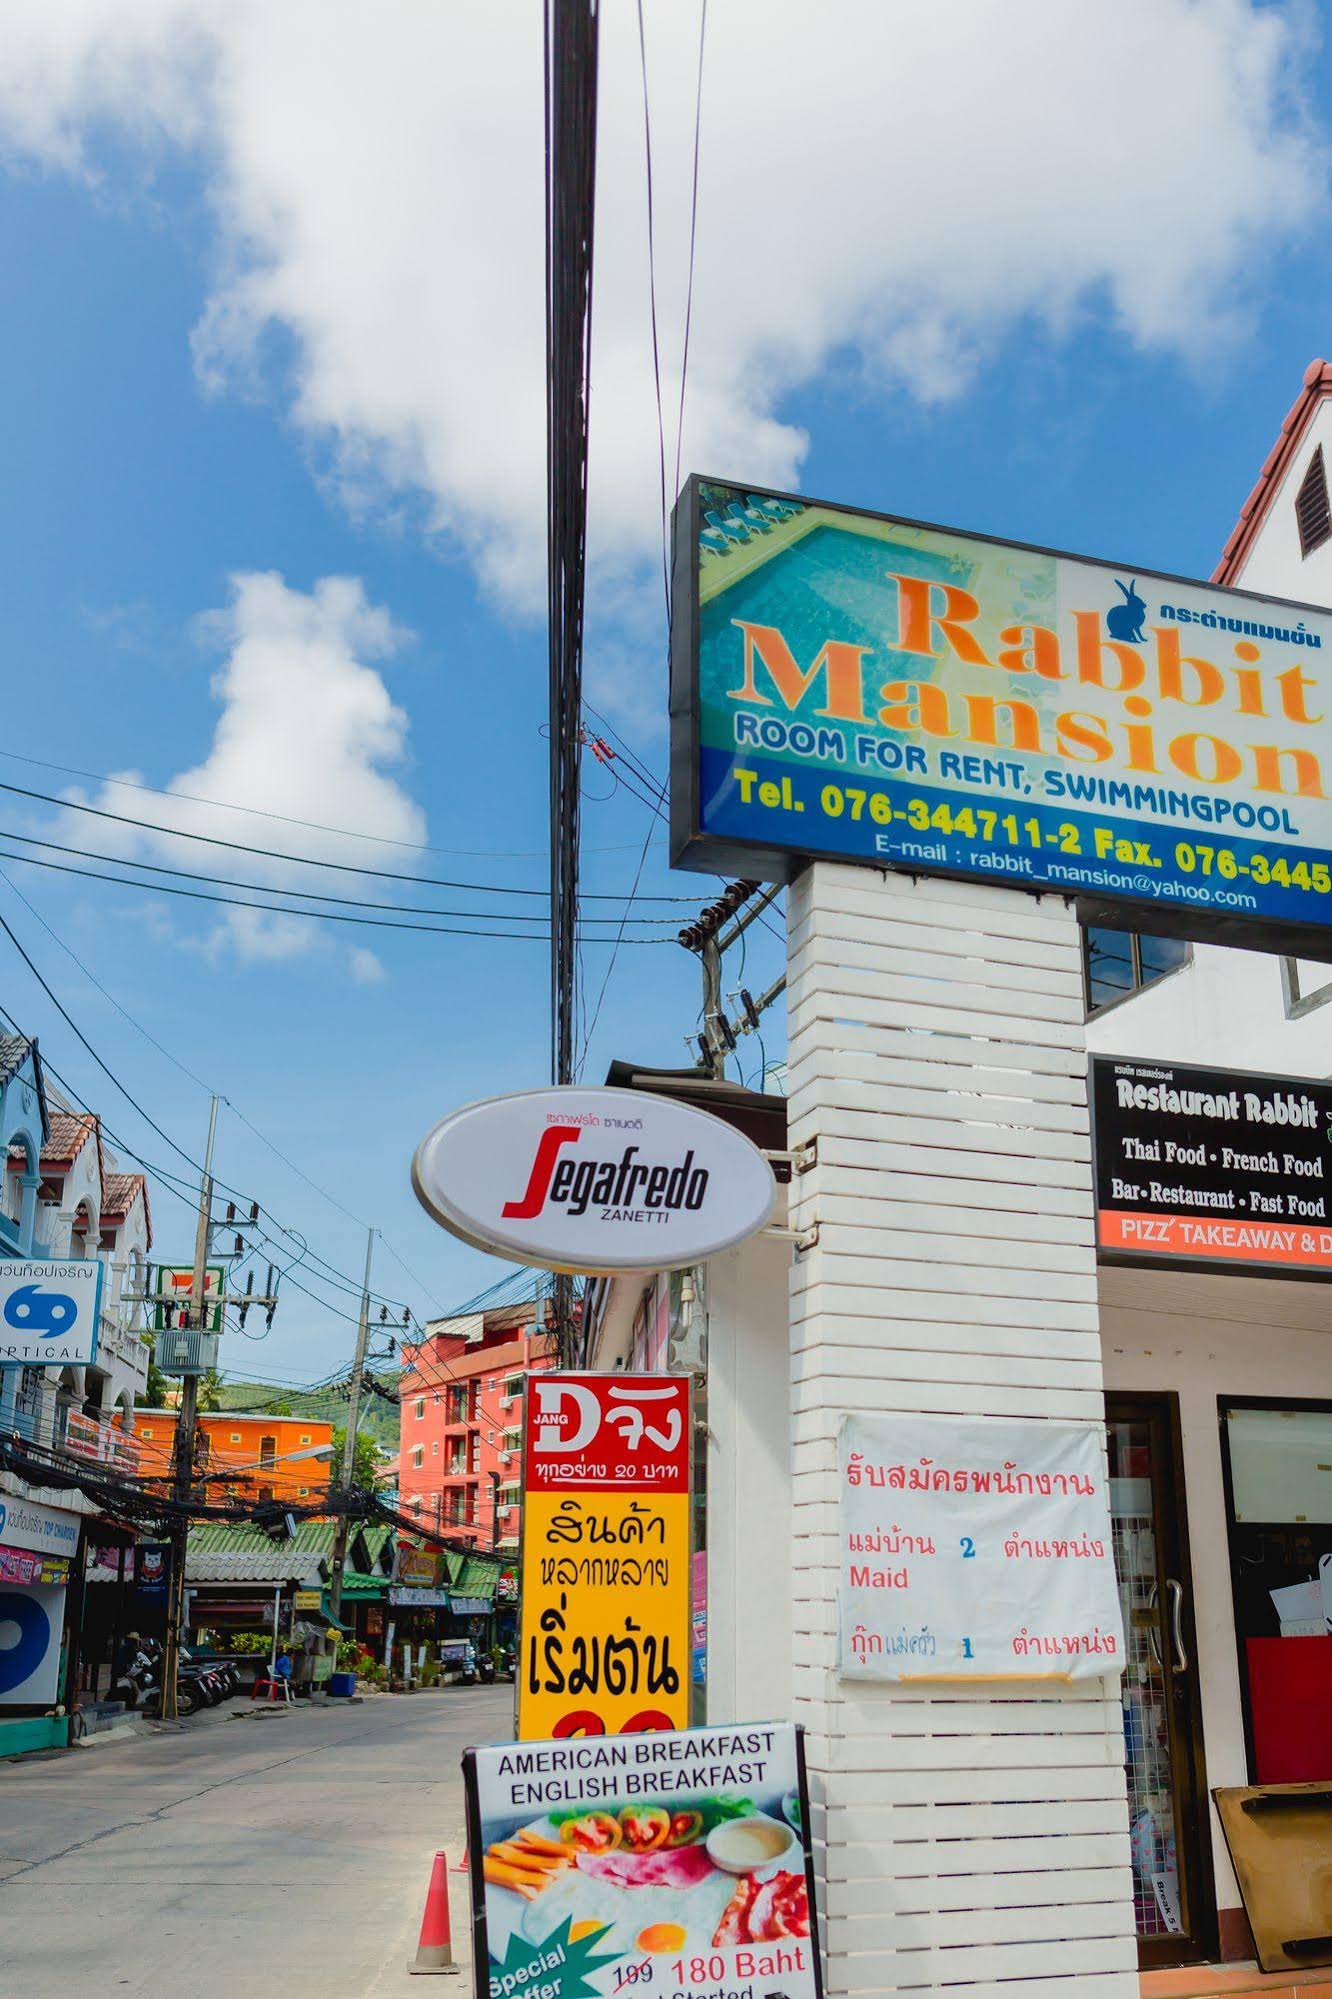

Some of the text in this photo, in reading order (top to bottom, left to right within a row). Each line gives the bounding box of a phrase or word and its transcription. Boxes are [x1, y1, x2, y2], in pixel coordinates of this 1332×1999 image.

[1160, 604, 1321, 648] กระต่ายแมนชั่น
[887, 572, 1326, 724] Rabbit
[727, 619, 1332, 800] Mansion
[736, 713, 1299, 835] ROOM FOR RENT, SWIMMINGPOOL
[734, 769, 1332, 893] Tel. 076-344711-2 Fax. 076-3445
[875, 834, 947, 861] E-mail
[970, 851, 1257, 908] rabbit_mansion@yahoo.com
[1116, 1078, 1318, 1129] Restaurant Rabbit
[501, 1126, 709, 1219] Segafredo
[1121, 1137, 1324, 1178] Thai Food French Food
[601, 1209, 669, 1224] ZANETTI
[1149, 1181, 1235, 1210] Restaurant
[1249, 1191, 1284, 1214] Fast
[1287, 1195, 1326, 1218] Food
[1179, 1223, 1297, 1251] TAKEAWAY
[1301, 1232, 1316, 1253] &
[0, 1346, 84, 1360] PTICAL
[533, 1414, 568, 1424] JANG
[535, 1454, 606, 1483] ทุกอย่าง
[642, 1463, 679, 1479] บาท
[847, 1453, 1095, 1495] รับสมัครพนักงาน
[546, 1500, 665, 1545] สินค้า
[849, 1525, 1105, 1558] แม่บ้าน 2 ตำแหน่ง
[540, 1557, 669, 1587] หลากหลาย
[850, 1566, 909, 1589] Maid
[529, 1592, 679, 1696] เริ่มต้น
[962, 1637, 974, 1658] 1
[1012, 1627, 1117, 1655] ตำแหน่ง
[498, 1732, 777, 1775] AMERICAN BREAKFAST
[511, 1762, 767, 1804] ENGLISH BREAKFAST
[671, 1956, 725, 1985] 180
[735, 1947, 806, 1978] Baht
